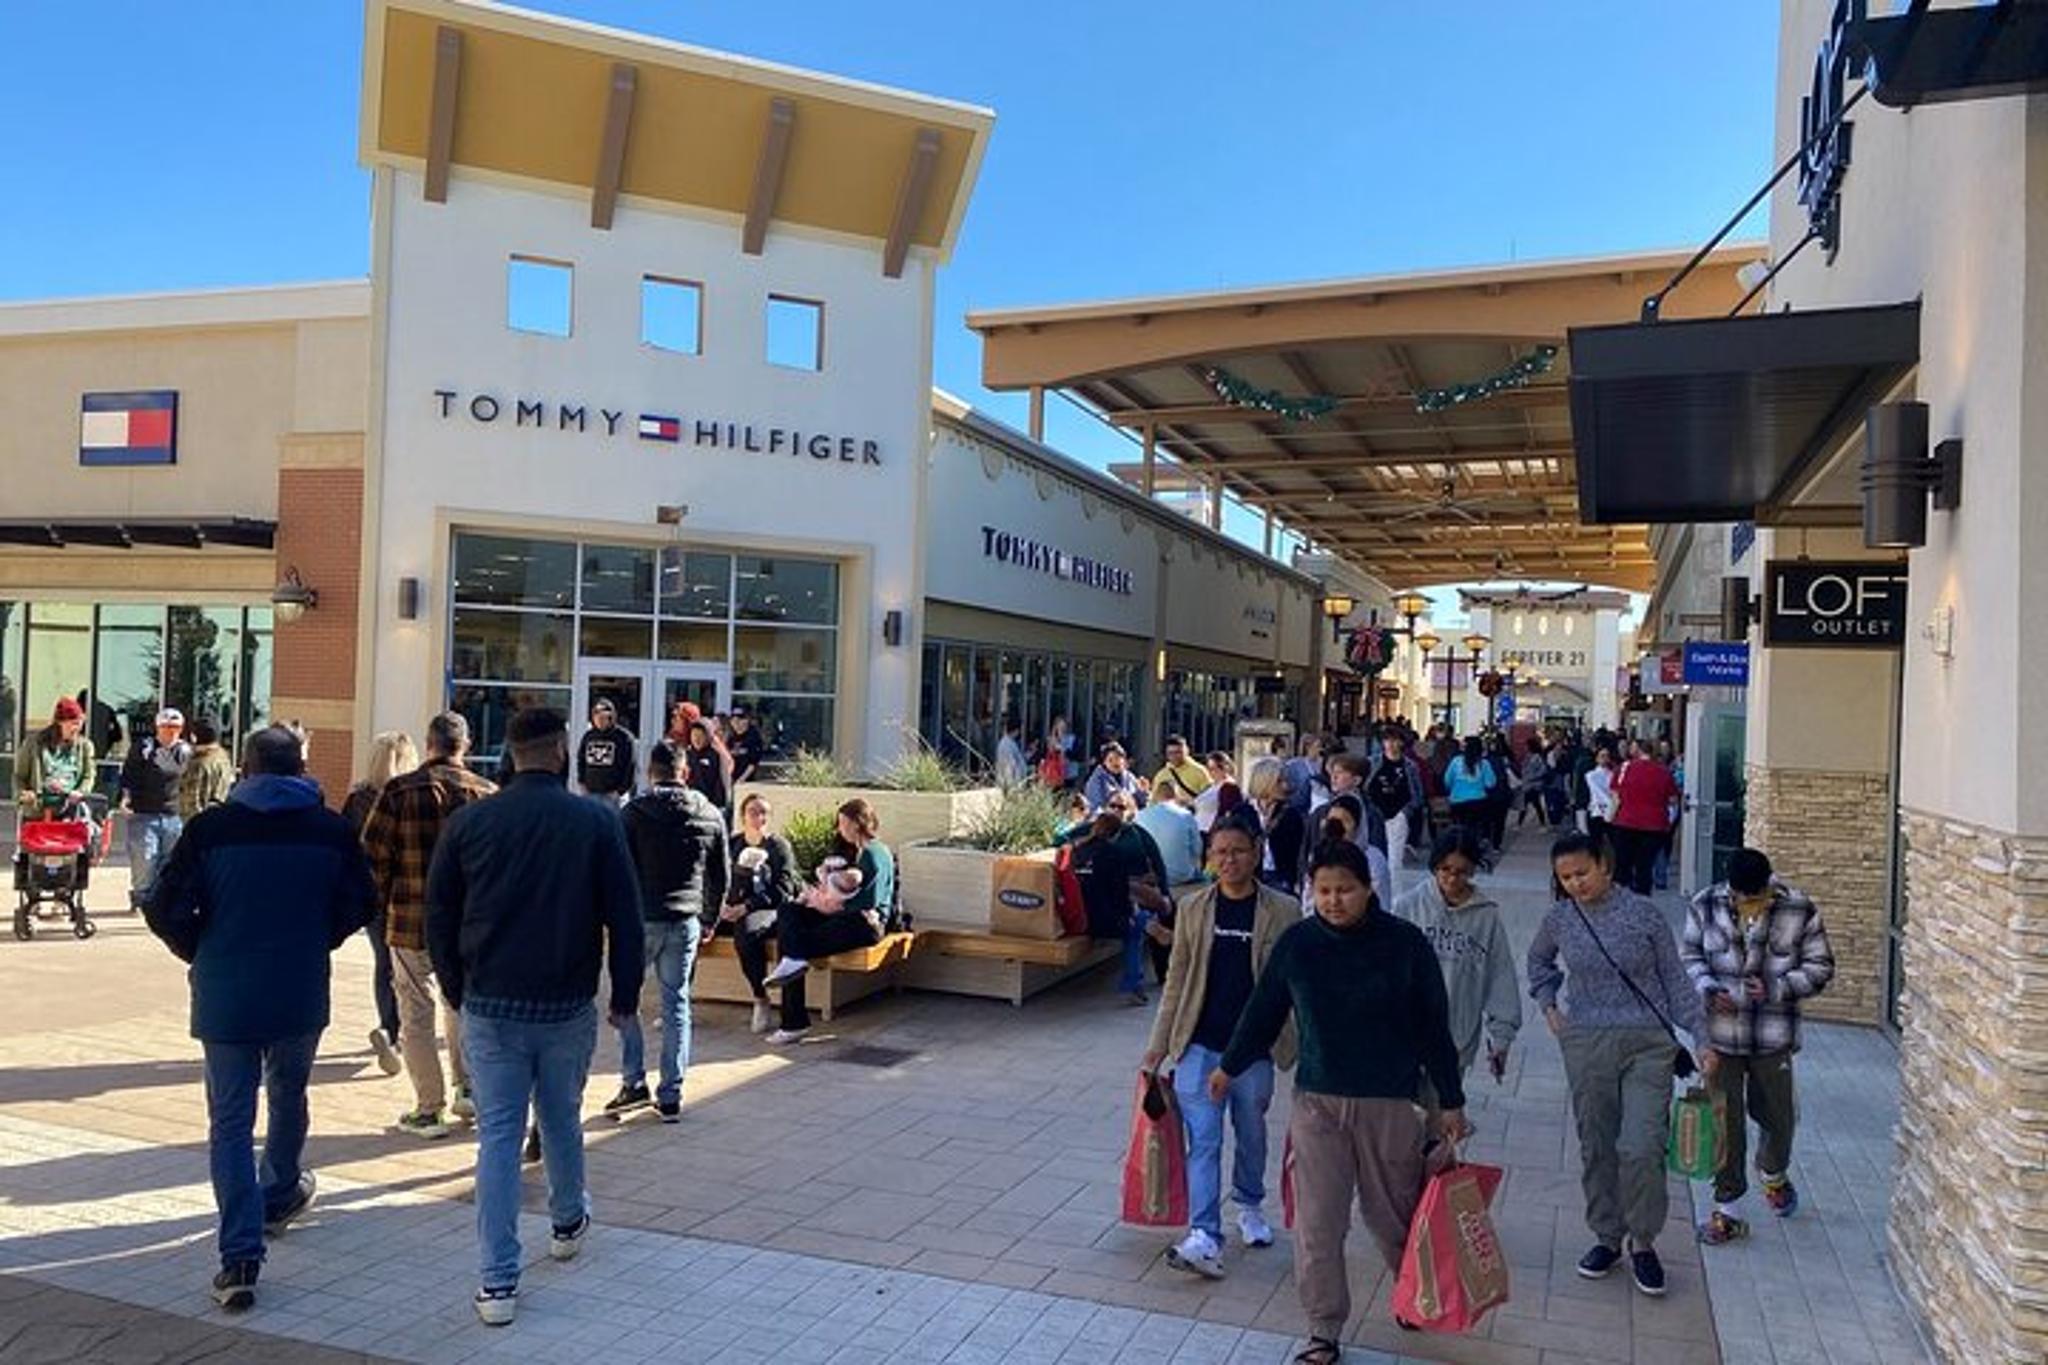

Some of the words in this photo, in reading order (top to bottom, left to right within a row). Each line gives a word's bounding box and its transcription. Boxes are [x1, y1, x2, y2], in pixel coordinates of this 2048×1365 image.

[434, 390, 622, 436] TOMMY
[694, 420, 881, 465] HILFIGER
[1811, 618, 1892, 636] OUTLET
